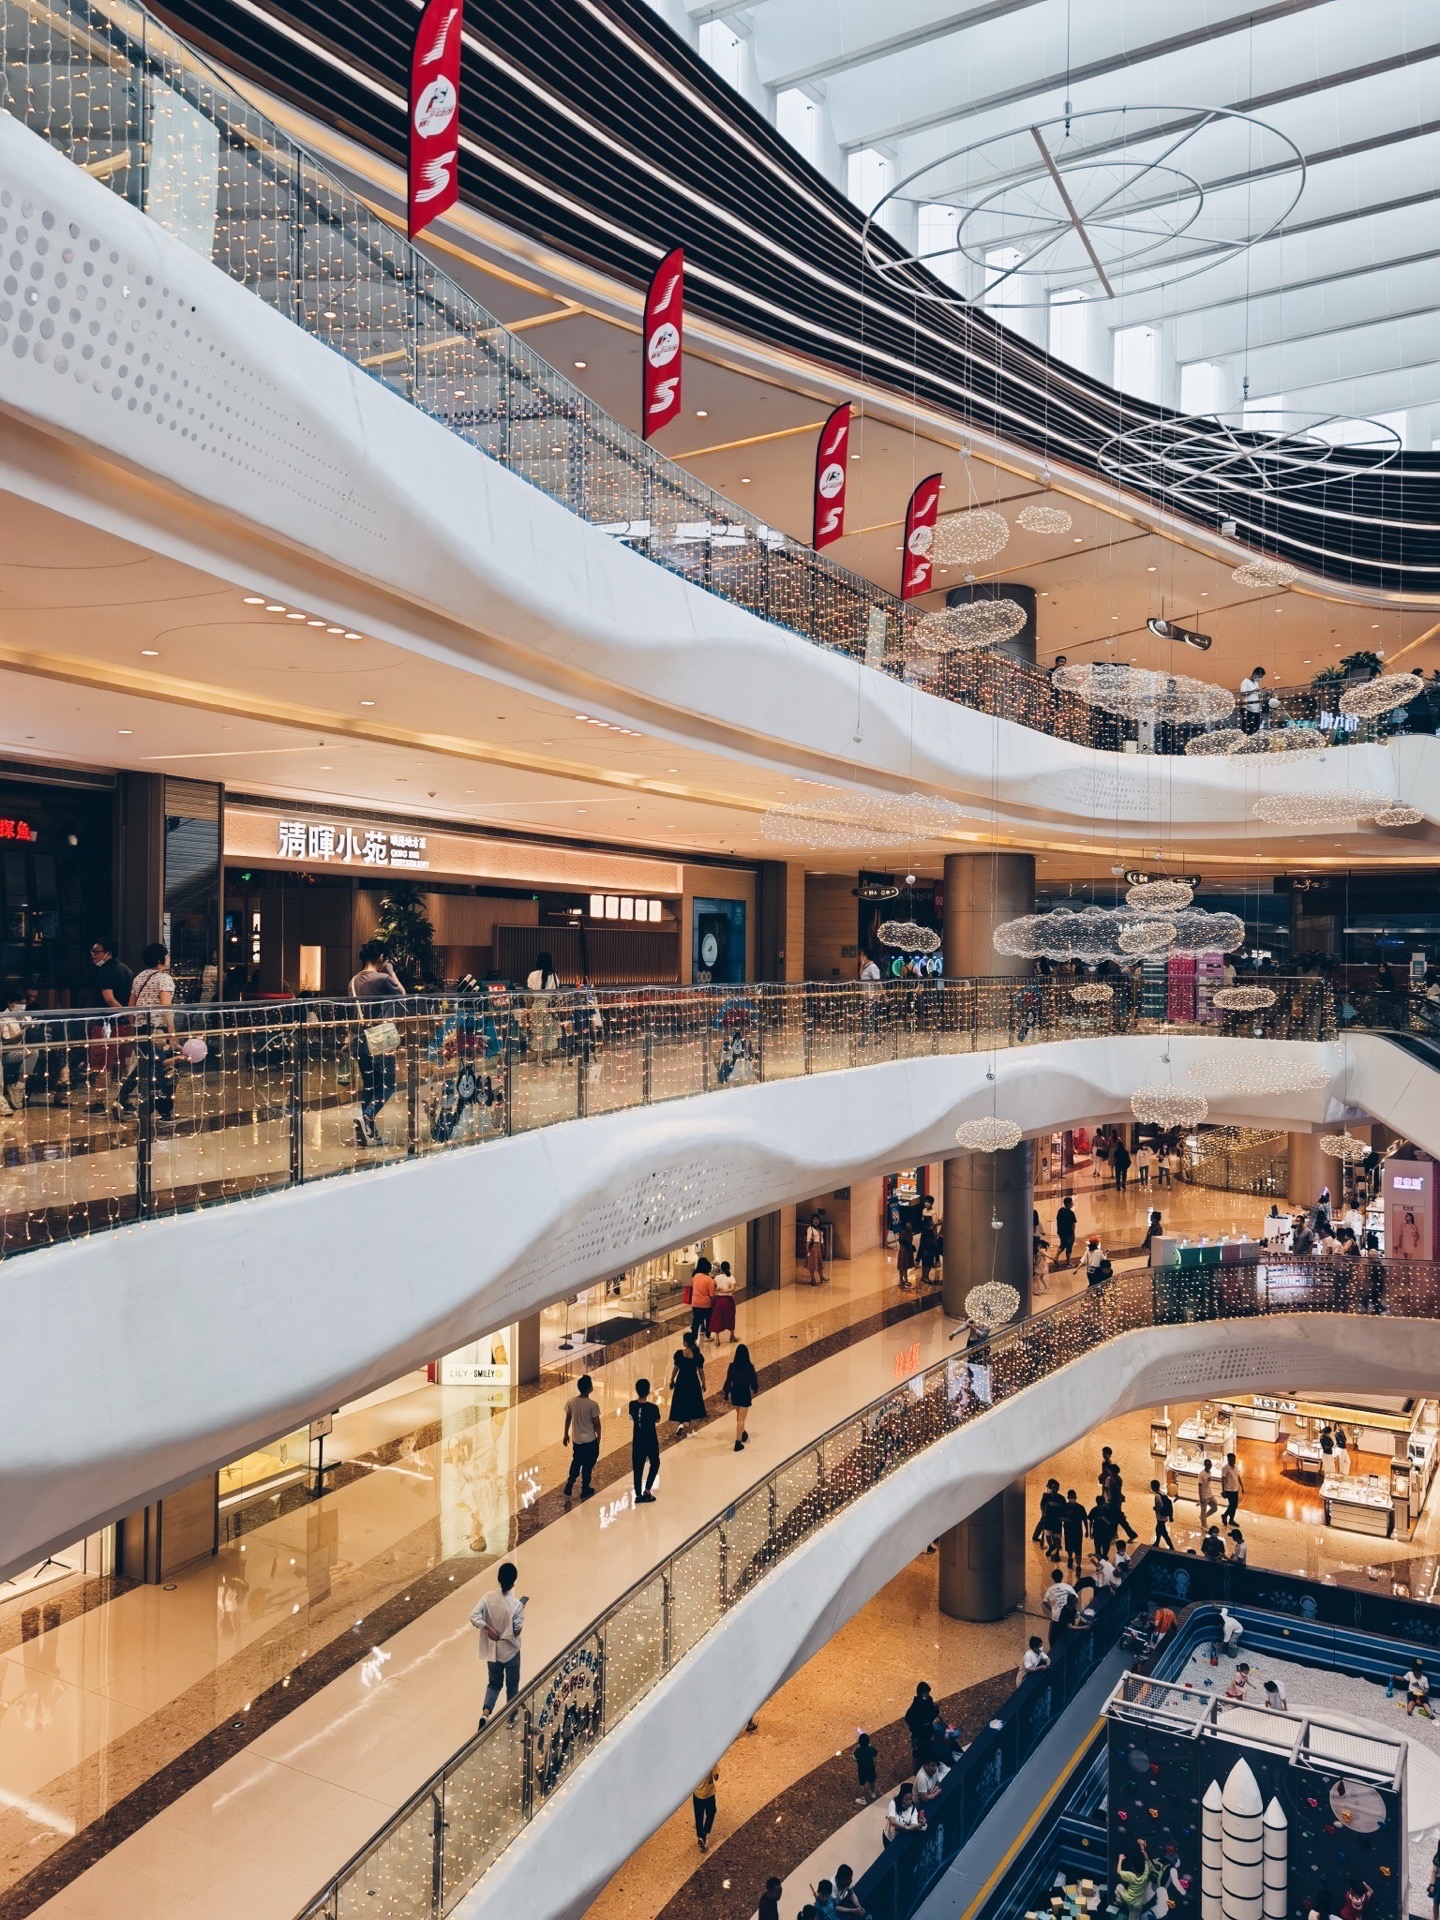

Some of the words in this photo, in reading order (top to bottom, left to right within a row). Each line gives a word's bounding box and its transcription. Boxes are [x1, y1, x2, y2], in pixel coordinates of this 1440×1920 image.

[450, 1369, 469, 1378] LILY
[473, 1369, 495, 1378] SMILEY
[1253, 1397, 1297, 1410] MSTAR
